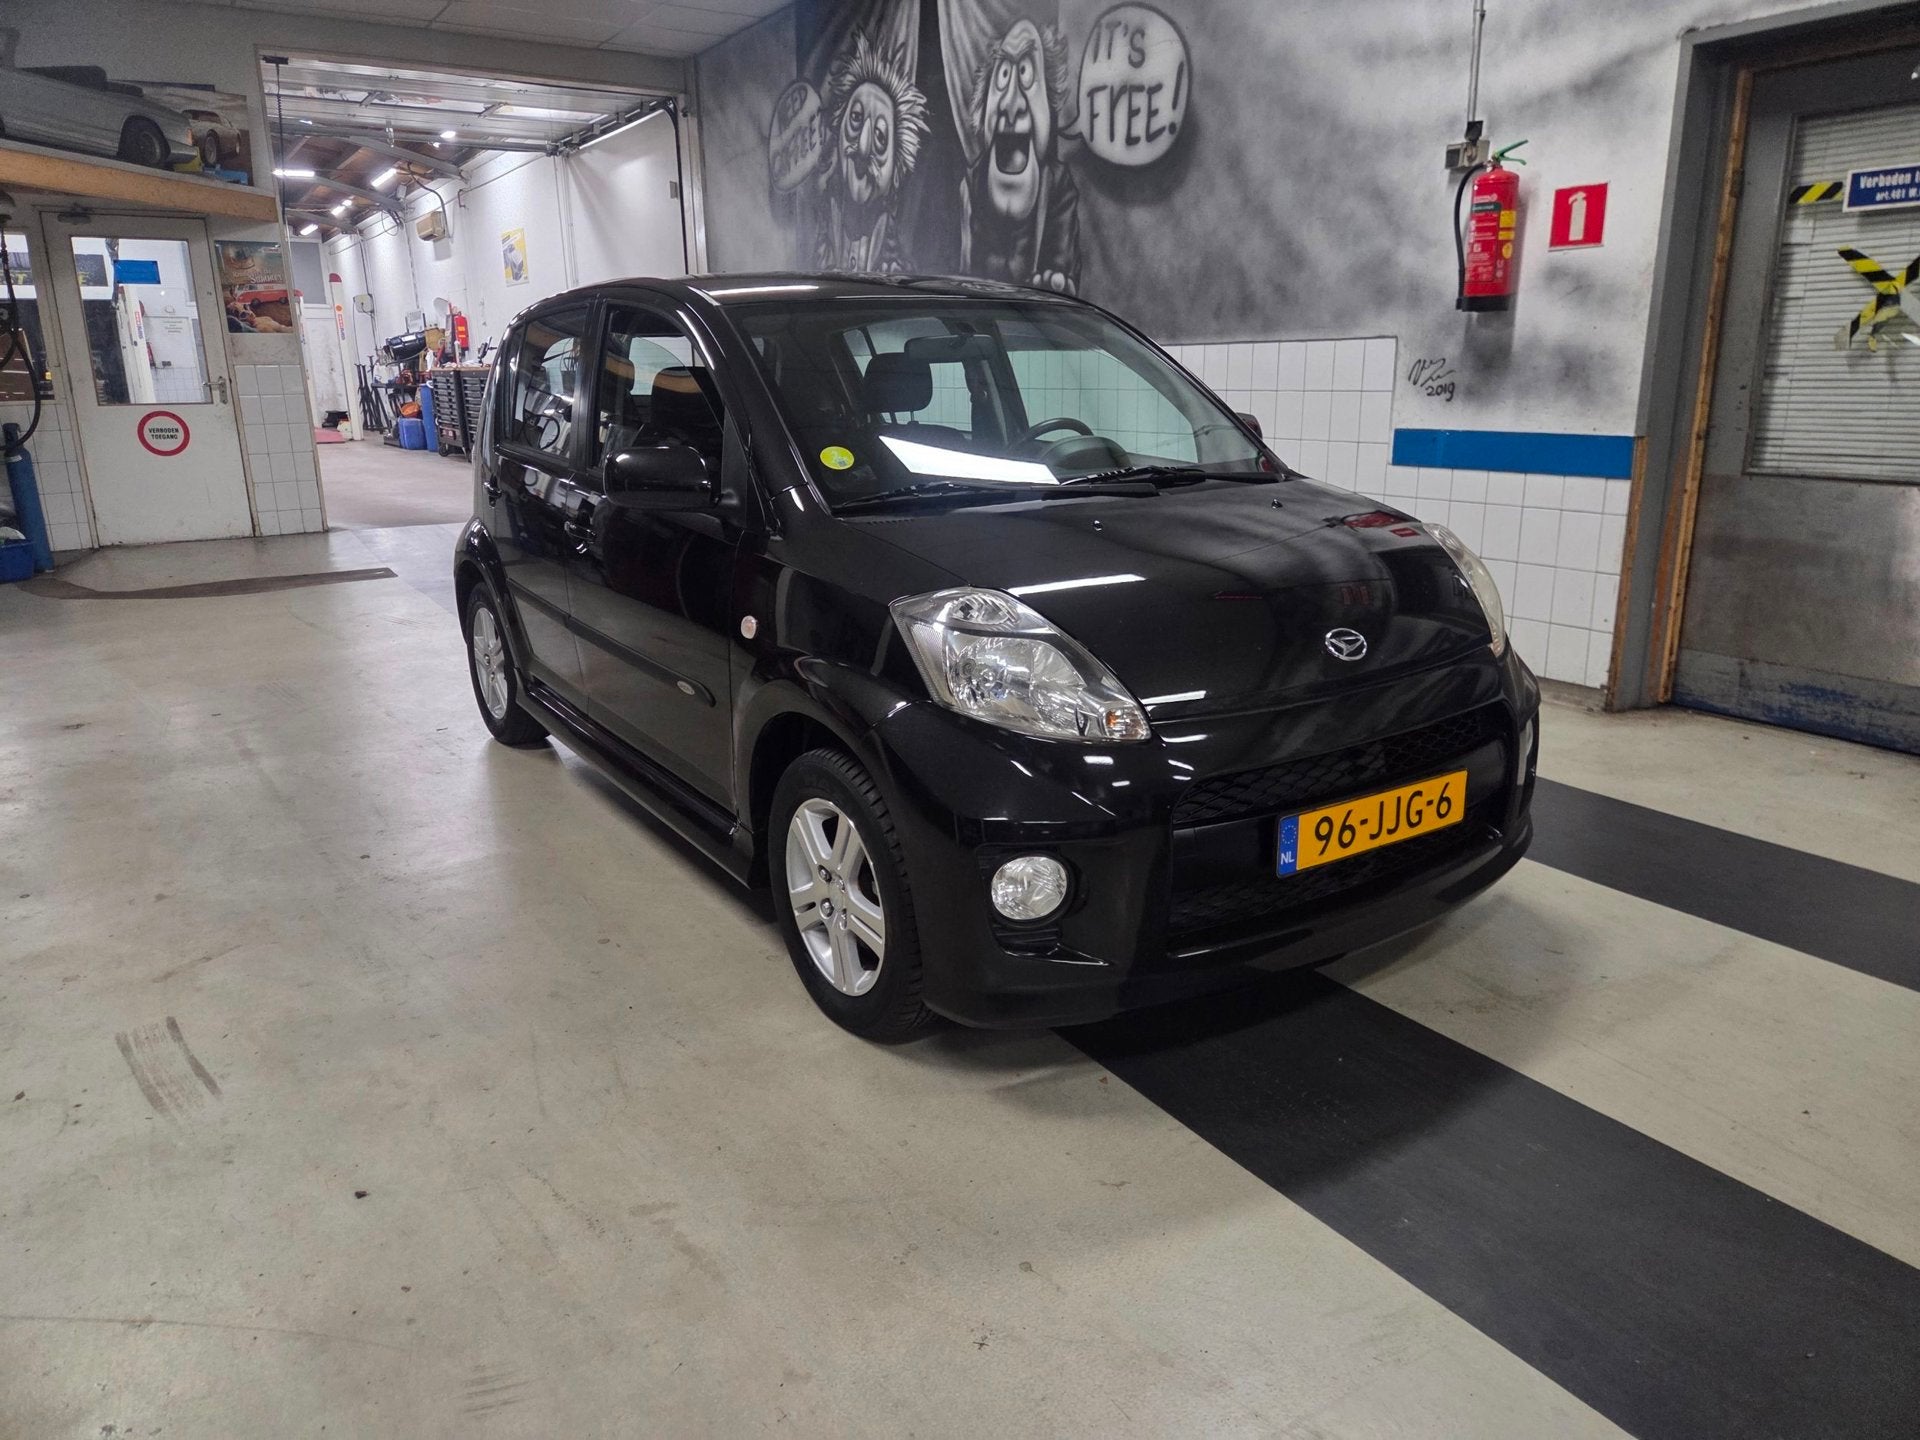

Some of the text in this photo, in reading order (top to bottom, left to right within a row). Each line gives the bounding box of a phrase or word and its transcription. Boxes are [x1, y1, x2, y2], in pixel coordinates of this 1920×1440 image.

[1093, 21, 1146, 69] IT'S
[1859, 172, 1912, 190] Verboden
[1425, 381, 1456, 402] 2019
[1314, 781, 1452, 856] 96-JJG-6
[1280, 851, 1295, 865] NL
